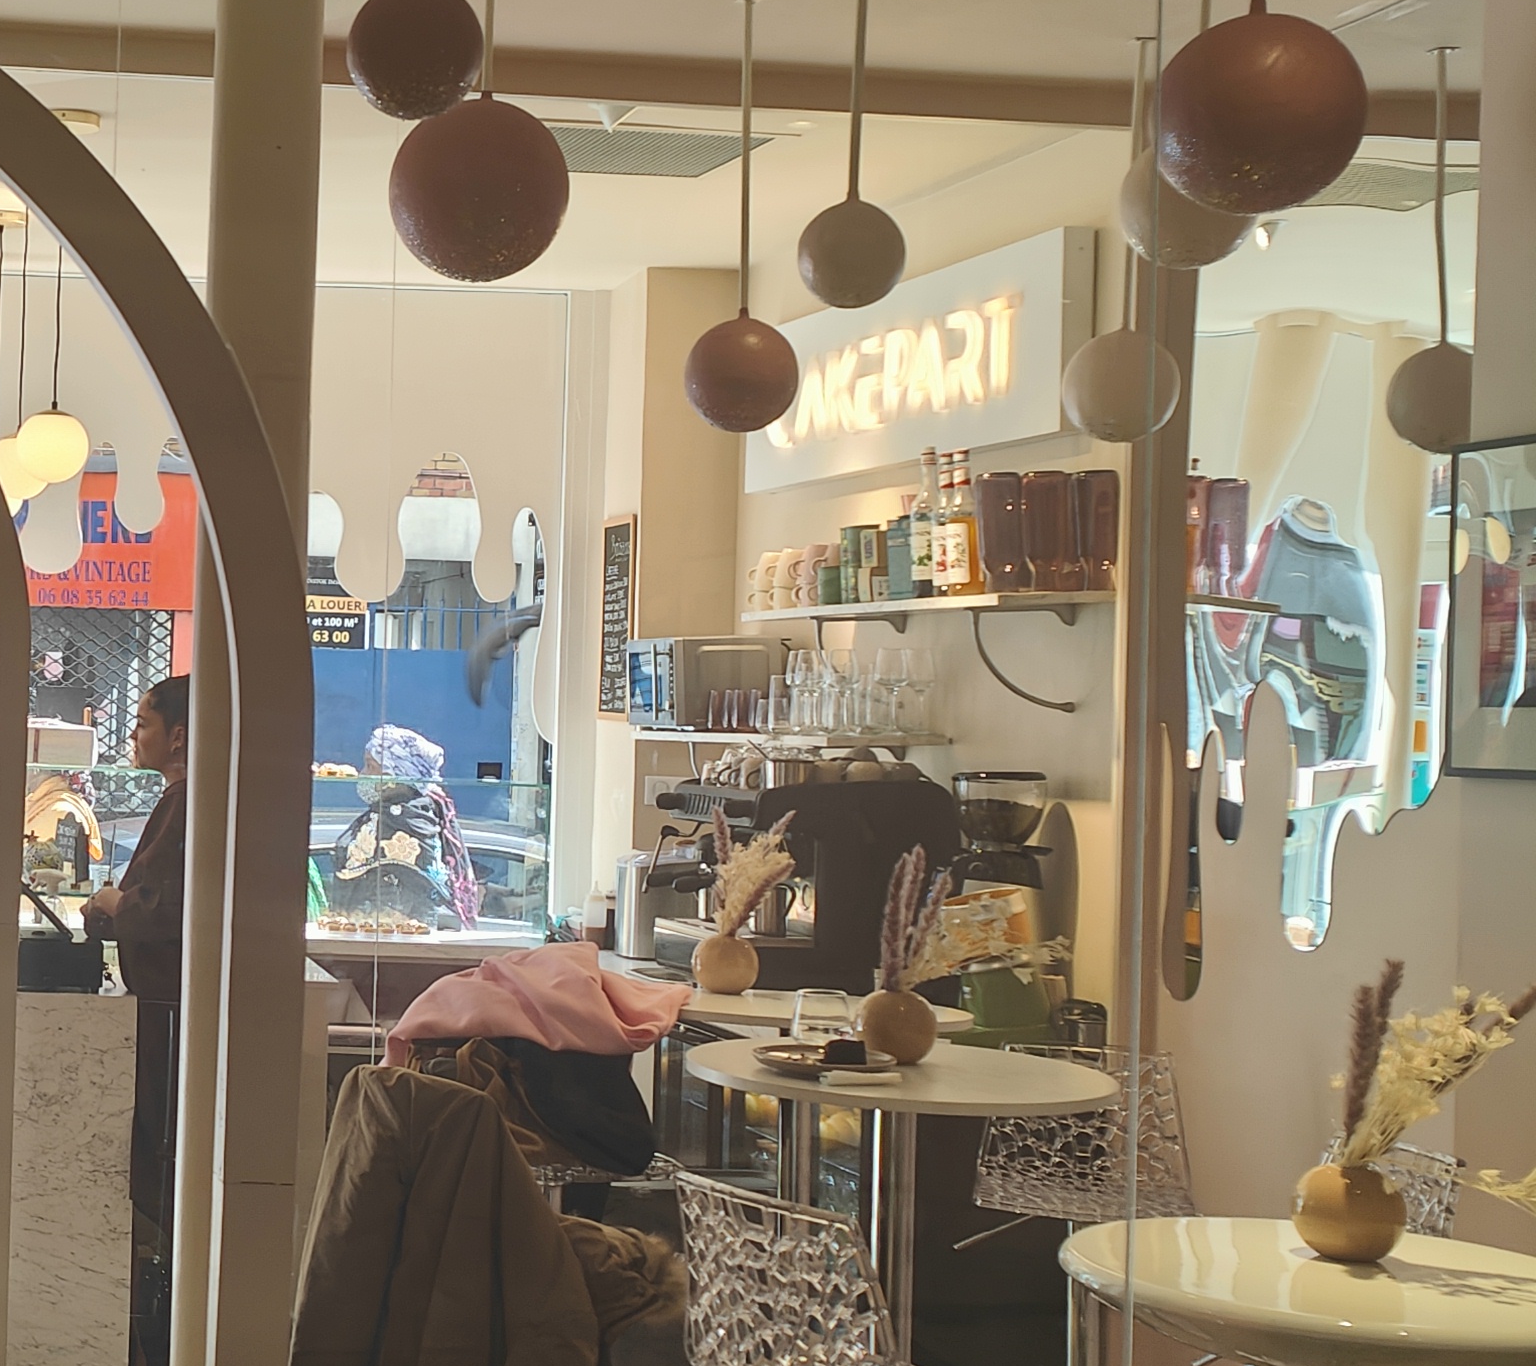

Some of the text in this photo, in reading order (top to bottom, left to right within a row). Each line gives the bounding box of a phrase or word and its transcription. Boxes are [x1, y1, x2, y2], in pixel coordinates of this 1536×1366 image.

[73, 559, 152, 583] VINTAGE
[320, 599, 362, 612] LOUER
[324, 617, 343, 627] 100
[312, 630, 350, 644] 63 00
